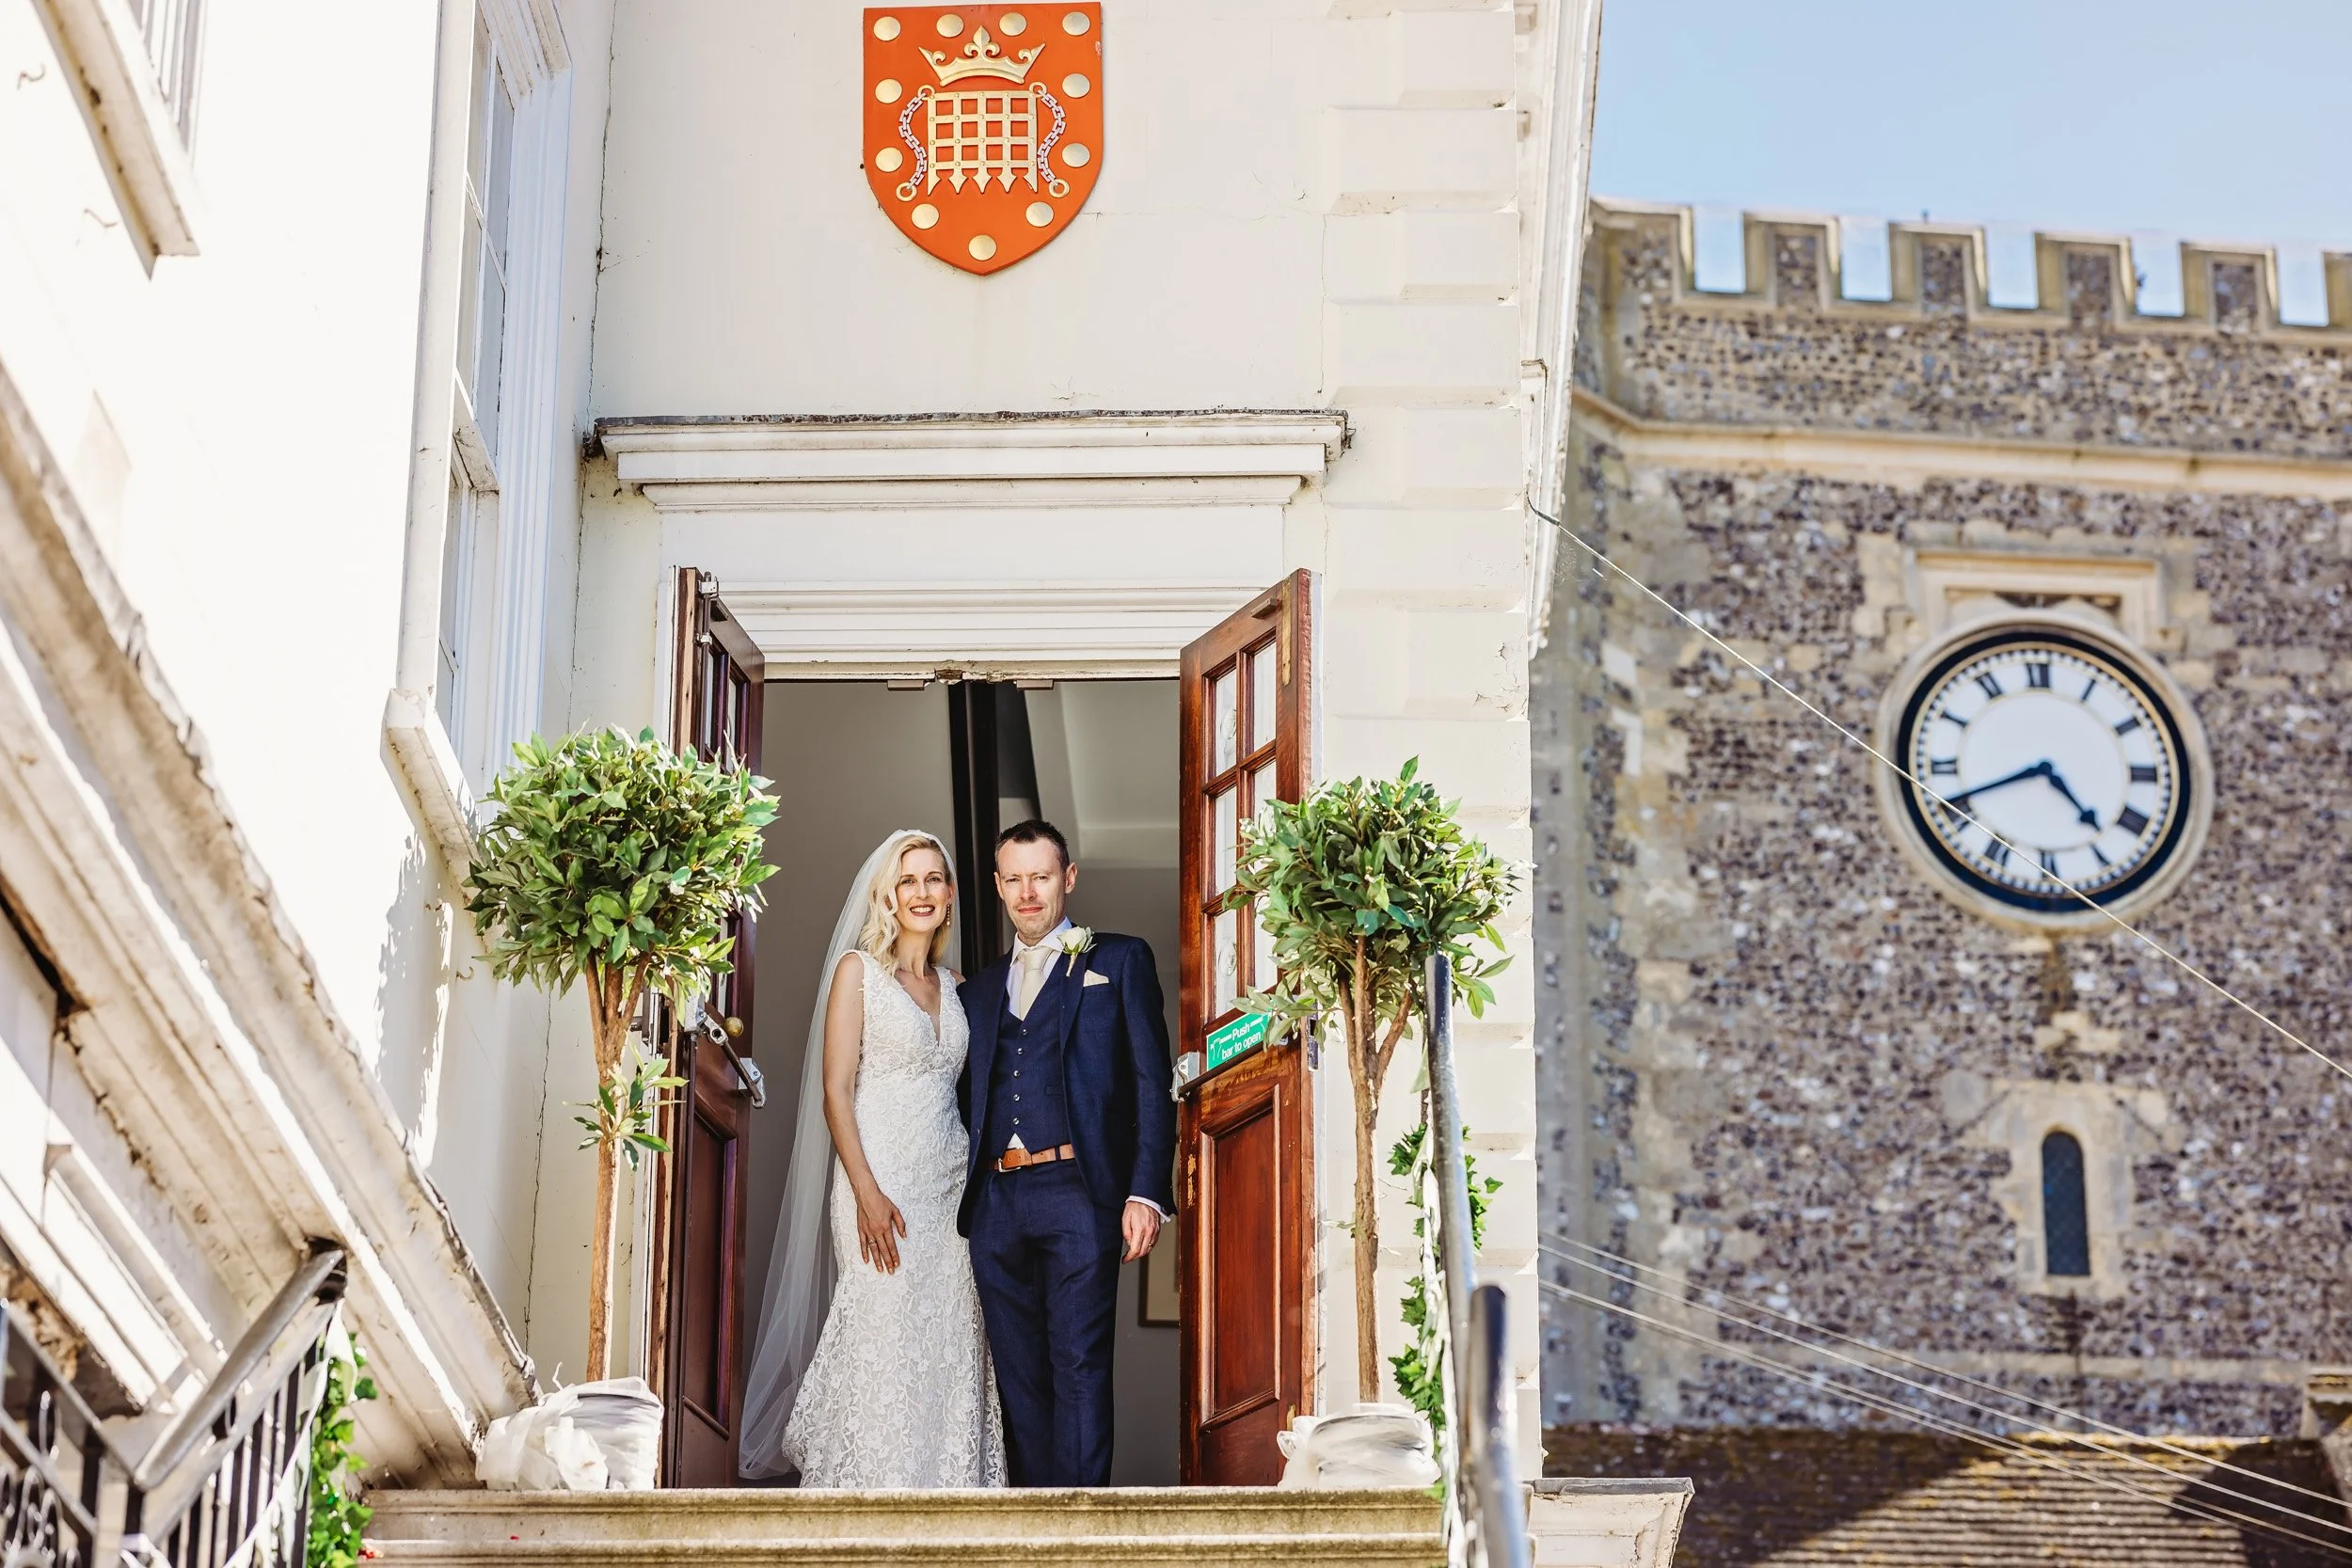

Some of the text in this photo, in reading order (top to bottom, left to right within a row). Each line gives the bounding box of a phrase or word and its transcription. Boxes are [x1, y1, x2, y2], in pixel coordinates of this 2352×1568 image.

[1232, 1022, 1250, 1041] Push
[1221, 1032, 1261, 1060] bar to open
